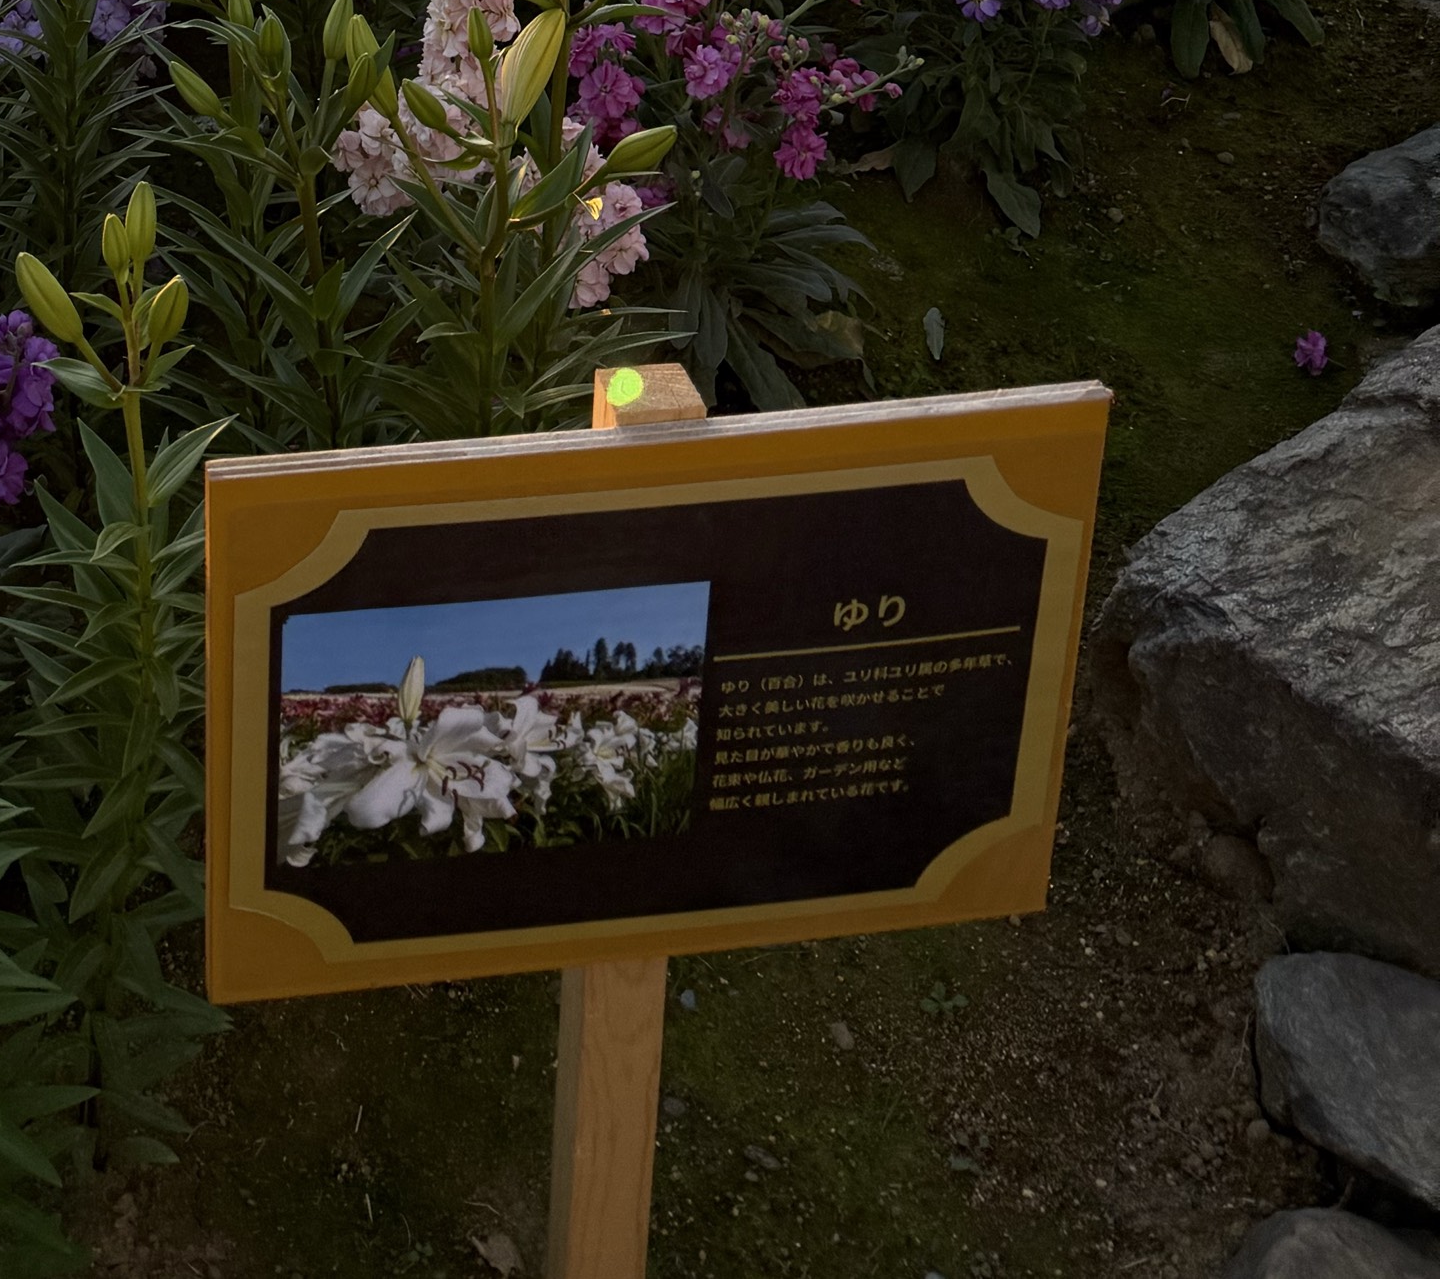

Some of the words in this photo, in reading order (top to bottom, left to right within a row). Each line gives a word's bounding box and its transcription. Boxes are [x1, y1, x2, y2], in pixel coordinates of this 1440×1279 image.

[833, 595, 906, 632] ゆり
[715, 720, 829, 742] 知られています。
